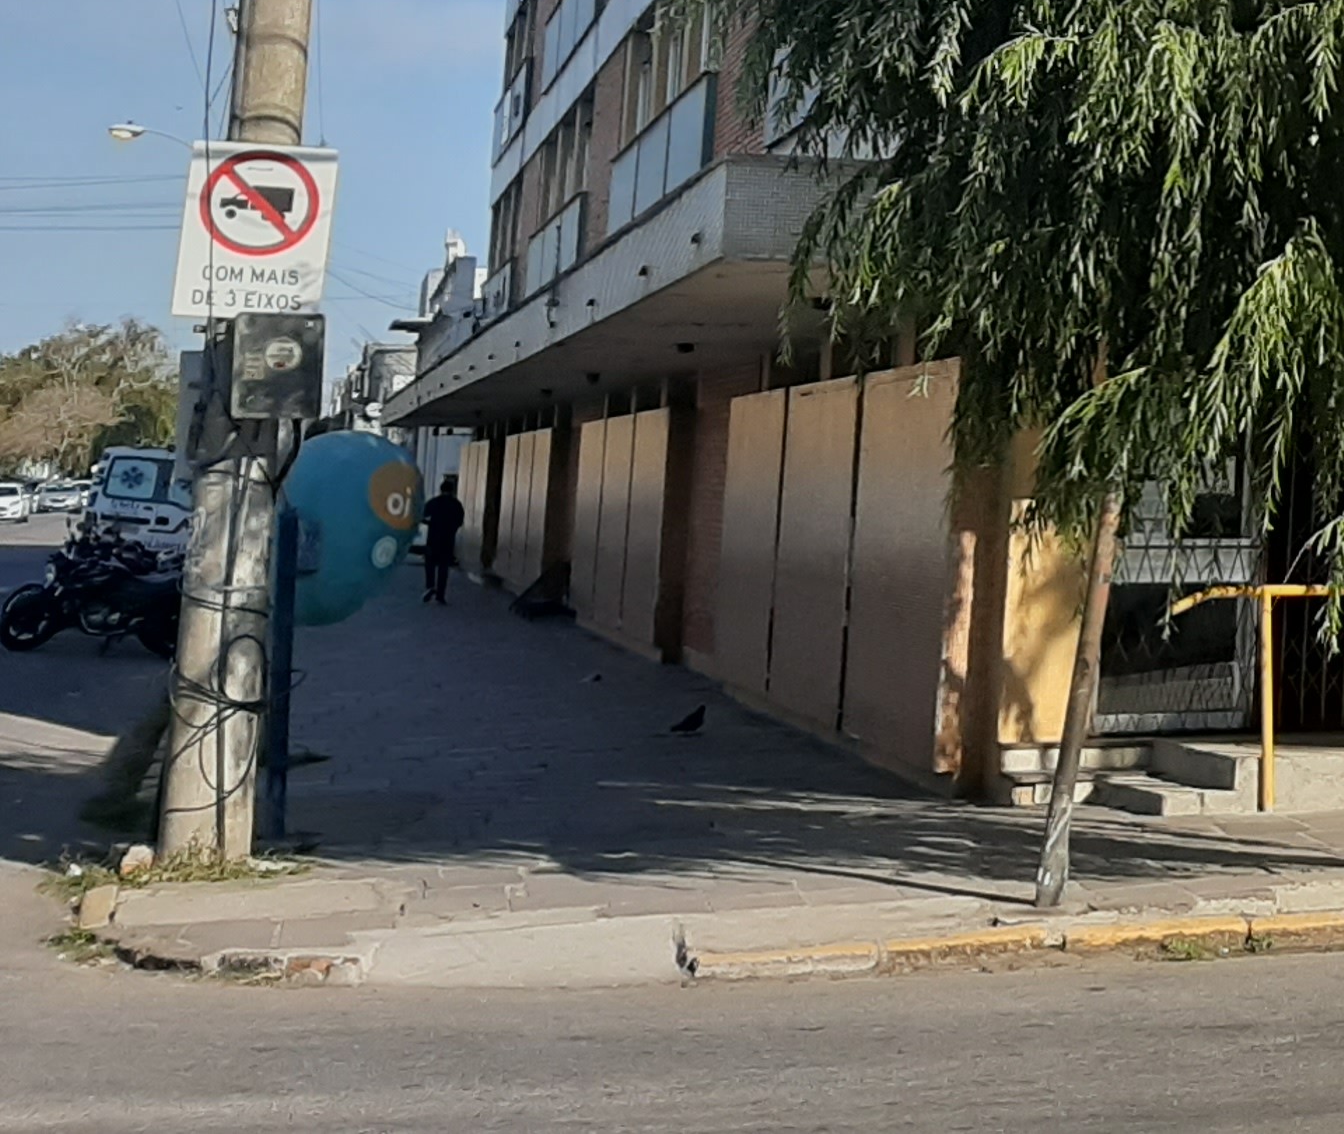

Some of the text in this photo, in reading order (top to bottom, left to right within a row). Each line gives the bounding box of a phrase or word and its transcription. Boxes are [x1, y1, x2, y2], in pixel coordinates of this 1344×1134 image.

[202, 265, 299, 286] COM MAIS
[192, 288, 302, 311] DE 3 EIXOS
